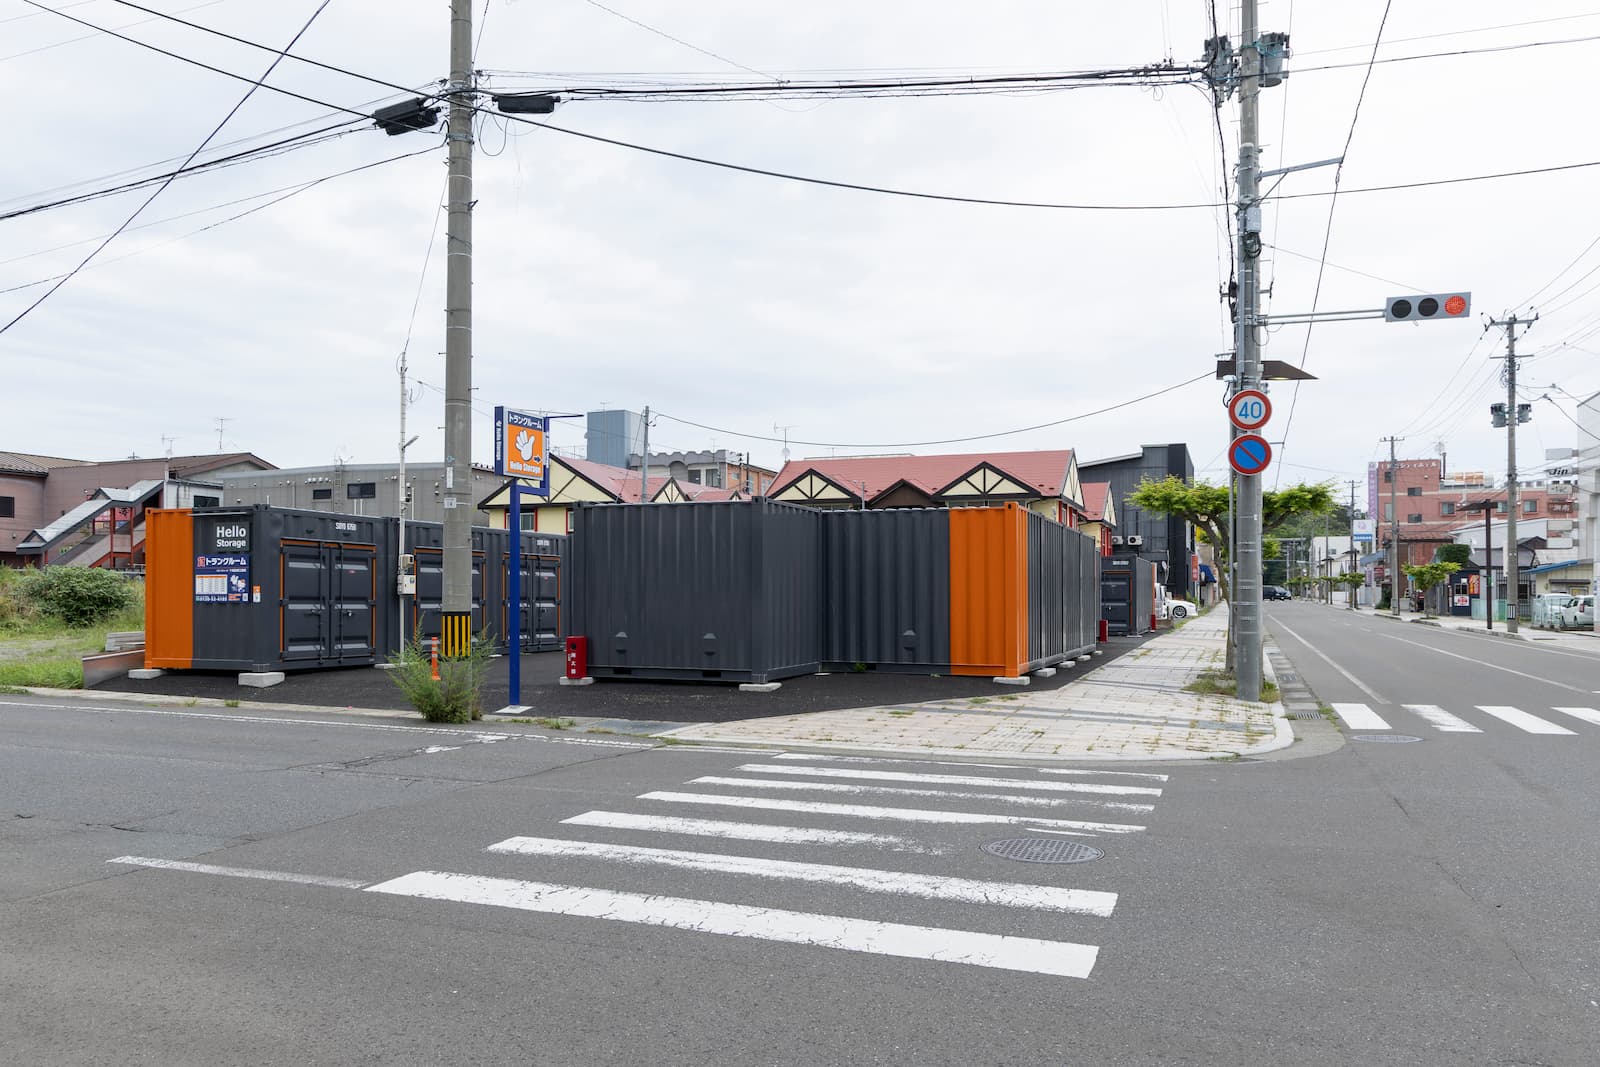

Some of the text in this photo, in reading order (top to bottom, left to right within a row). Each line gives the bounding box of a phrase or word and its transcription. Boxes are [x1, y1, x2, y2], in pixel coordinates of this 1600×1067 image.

[1239, 401, 1262, 419] 40
[509, 413, 542, 429] トランクルーム
[216, 525, 246, 538] Hello
[216, 538, 246, 548] Storage
[206, 557, 246, 566] トランクルーム
